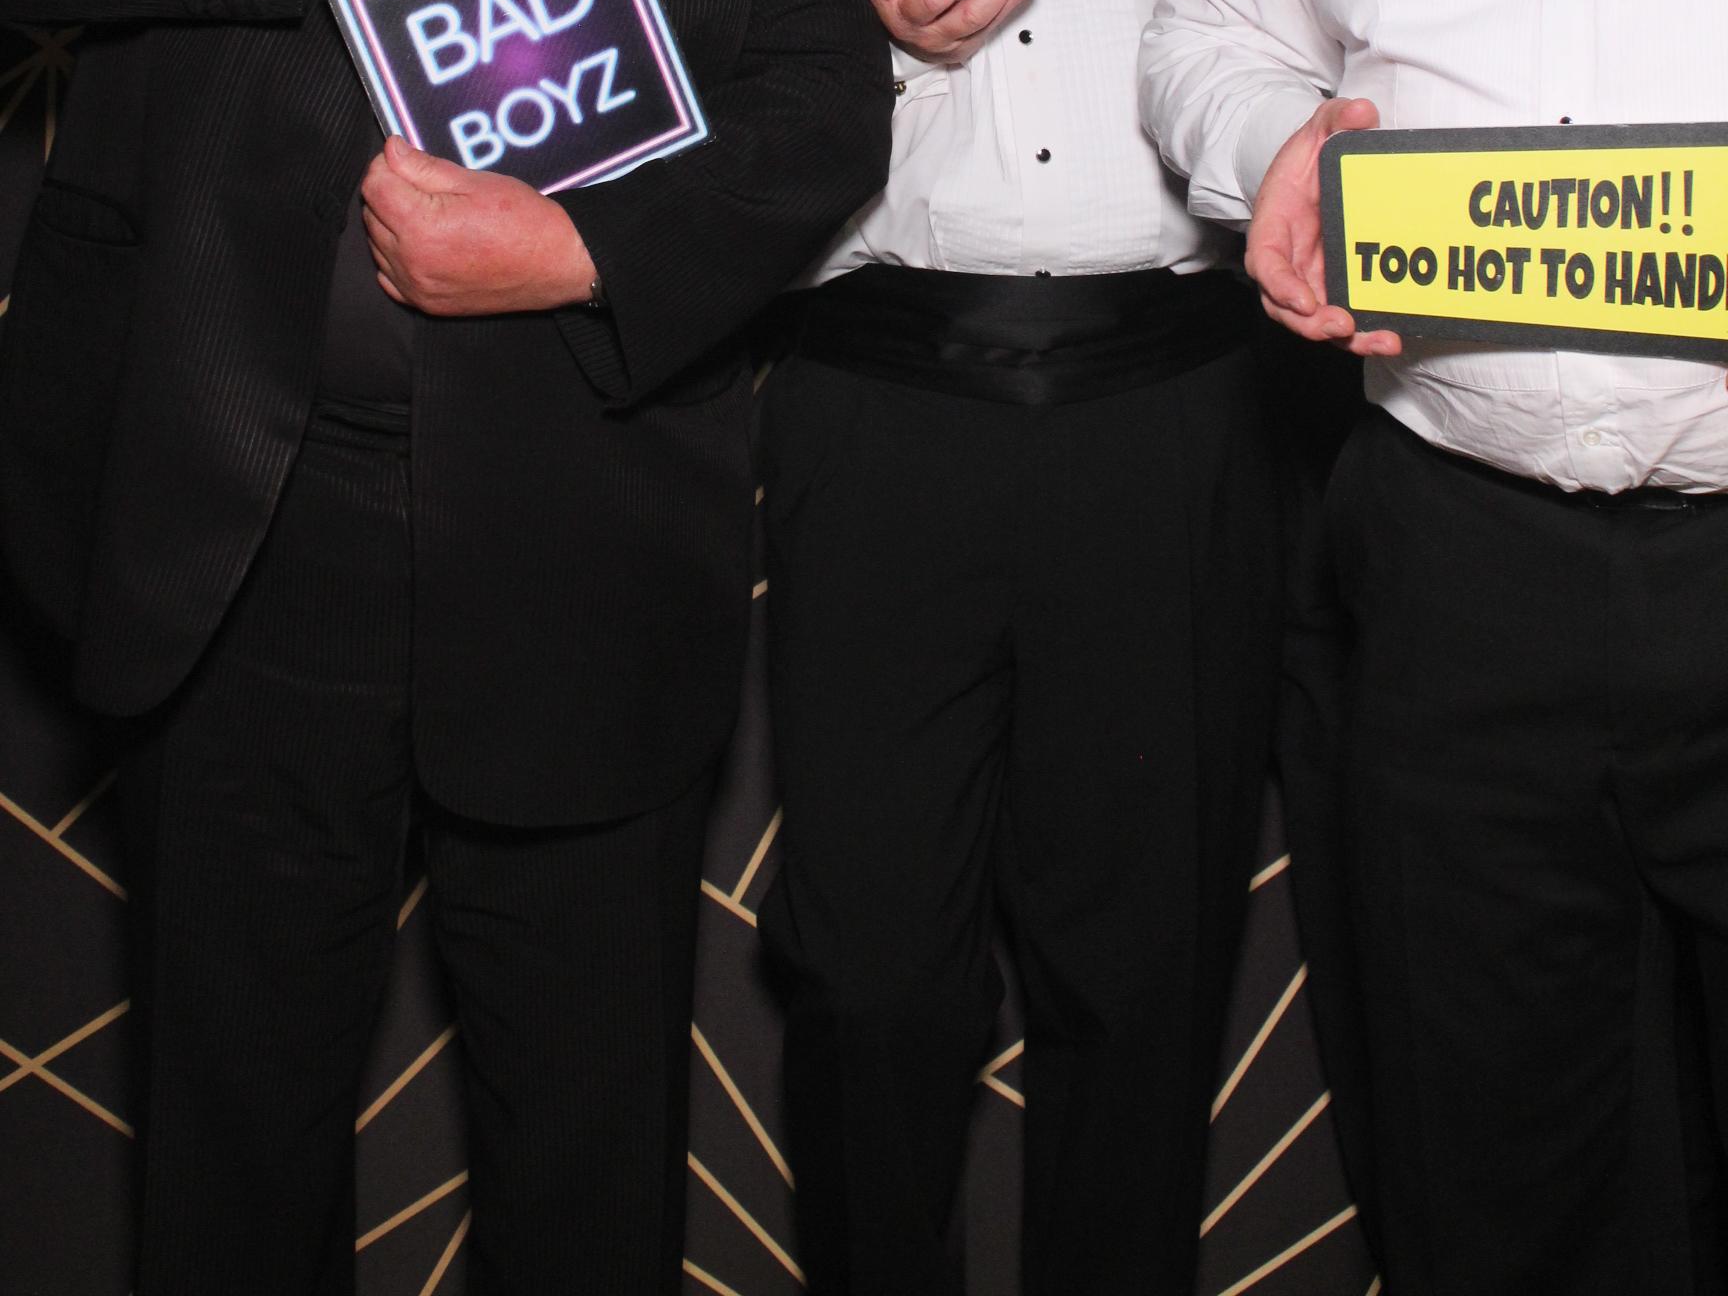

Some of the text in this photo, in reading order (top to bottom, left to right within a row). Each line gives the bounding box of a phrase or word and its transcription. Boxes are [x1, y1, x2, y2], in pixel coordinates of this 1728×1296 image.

[449, 47, 637, 171] BOYZ
[1468, 170, 1694, 237] CAUTION!!
[1355, 241, 1728, 312] TOO HOT TO HAND
